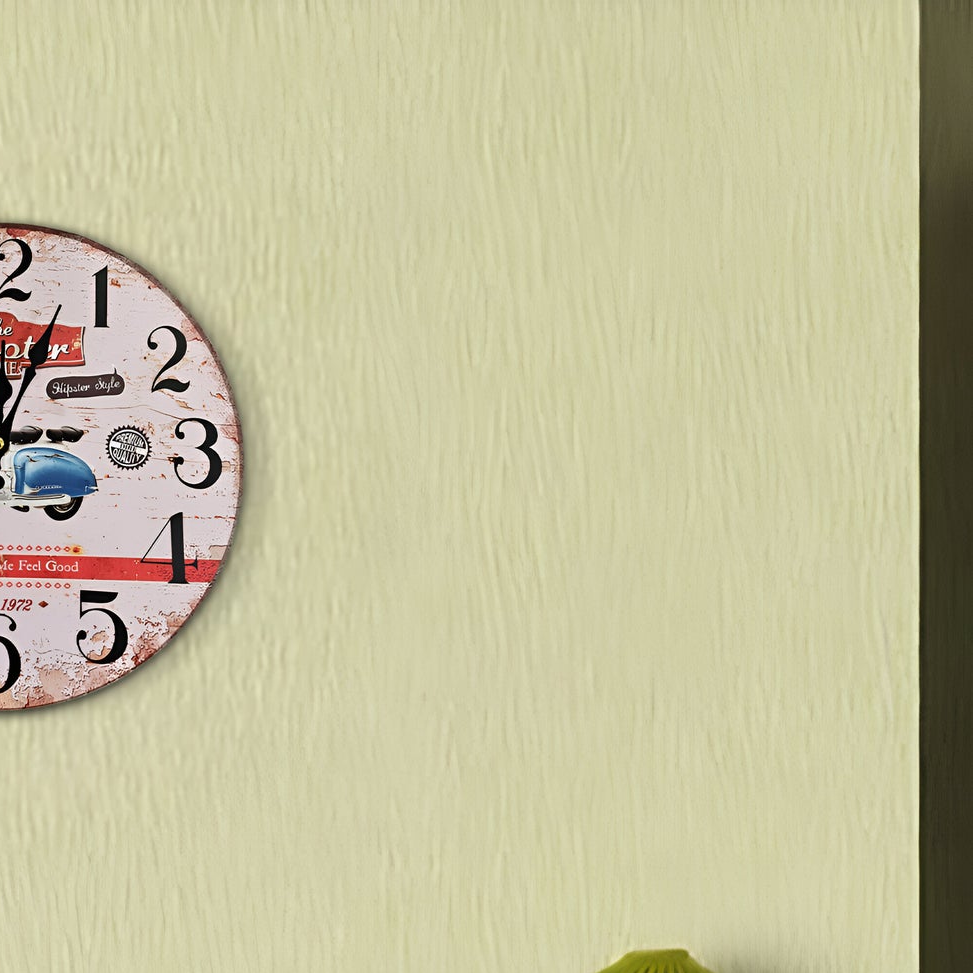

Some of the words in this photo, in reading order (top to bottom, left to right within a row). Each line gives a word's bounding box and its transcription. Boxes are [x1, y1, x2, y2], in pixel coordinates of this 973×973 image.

[92, 265, 109, 328] 1
[52, 381, 91, 398] Hipster
[95, 378, 121, 391] Style
[147, 326, 190, 392] 2
[173, 417, 222, 489] 3
[18, 559, 41, 571] Feel
[45, 560, 79, 572] Good
[140, 511, 199, 584] 4
[1, 598, 33, 611] 1972
[75, 590, 128, 664] 5
